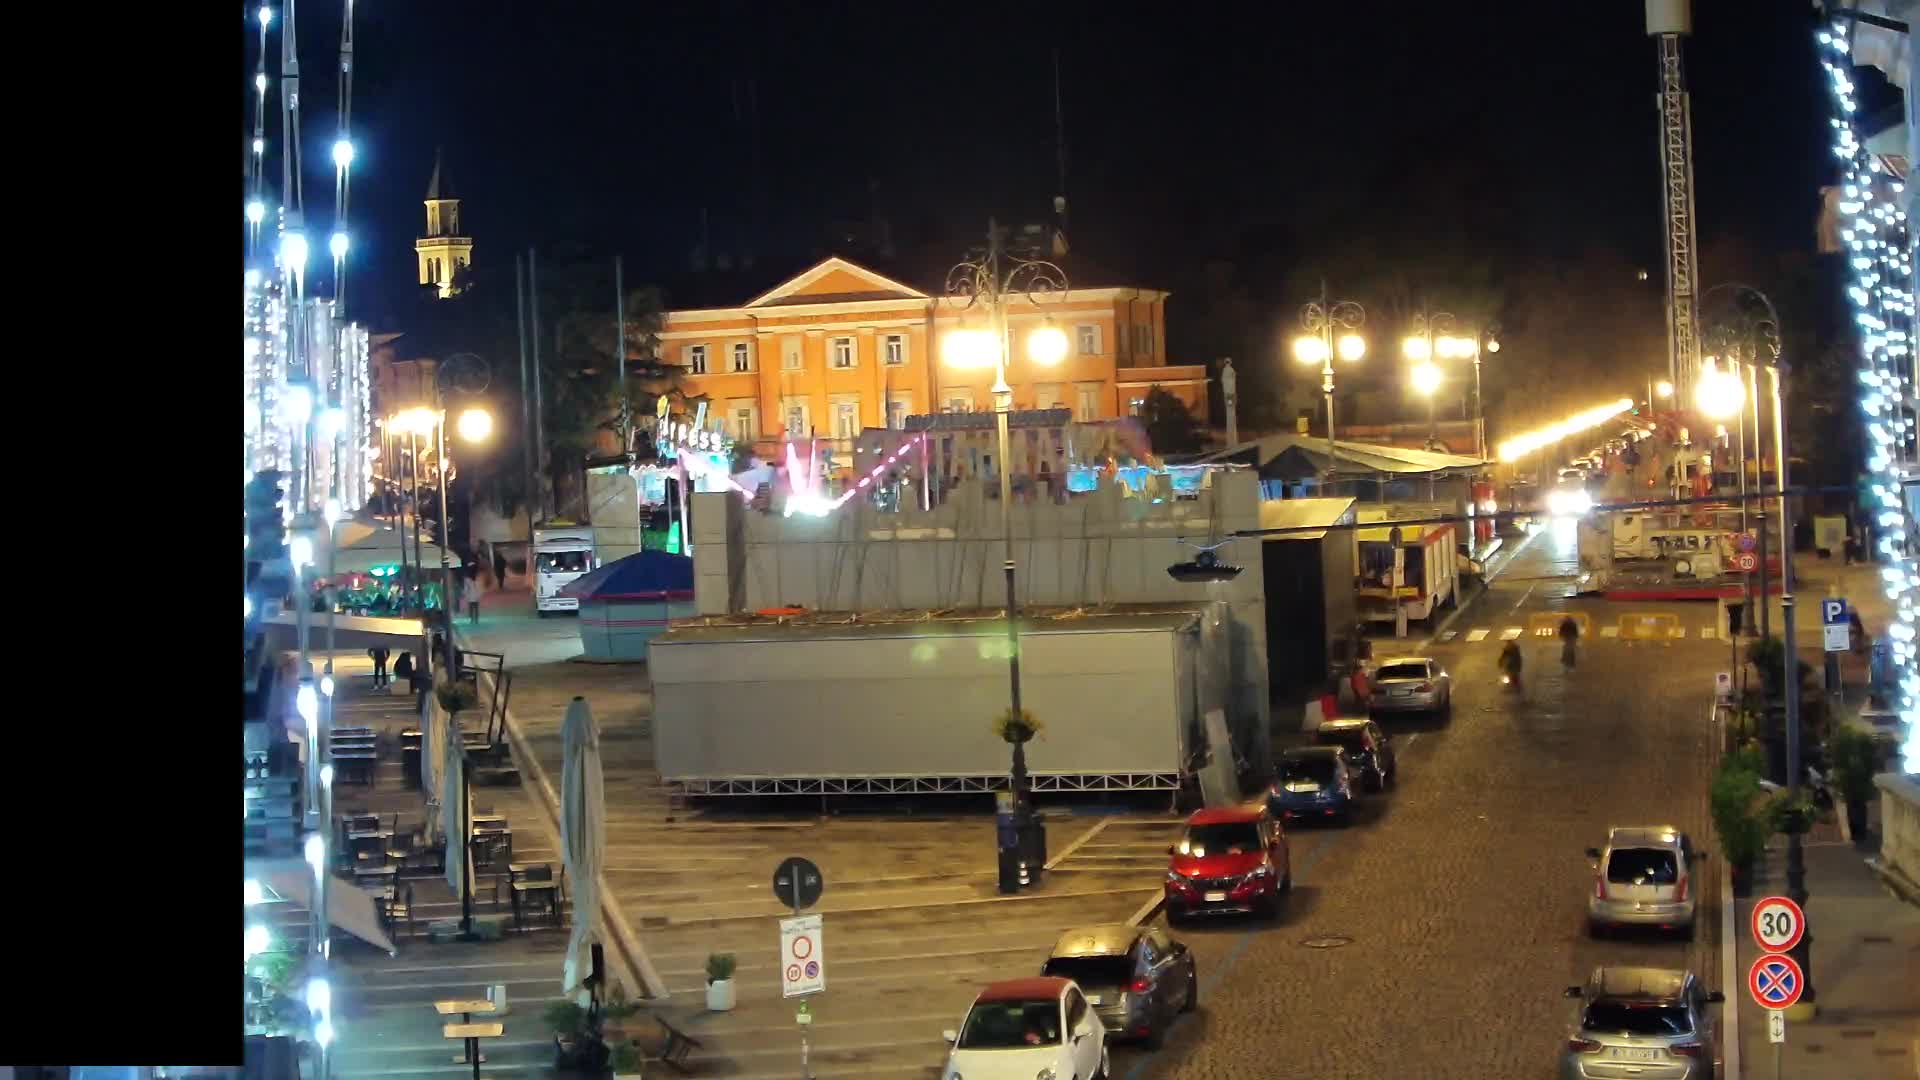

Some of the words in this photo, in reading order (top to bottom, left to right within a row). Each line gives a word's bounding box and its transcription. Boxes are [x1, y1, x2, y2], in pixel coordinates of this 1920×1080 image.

[1742, 557, 1753, 567] 20
[1827, 602, 1842, 622] P
[1762, 912, 1791, 937] 30
